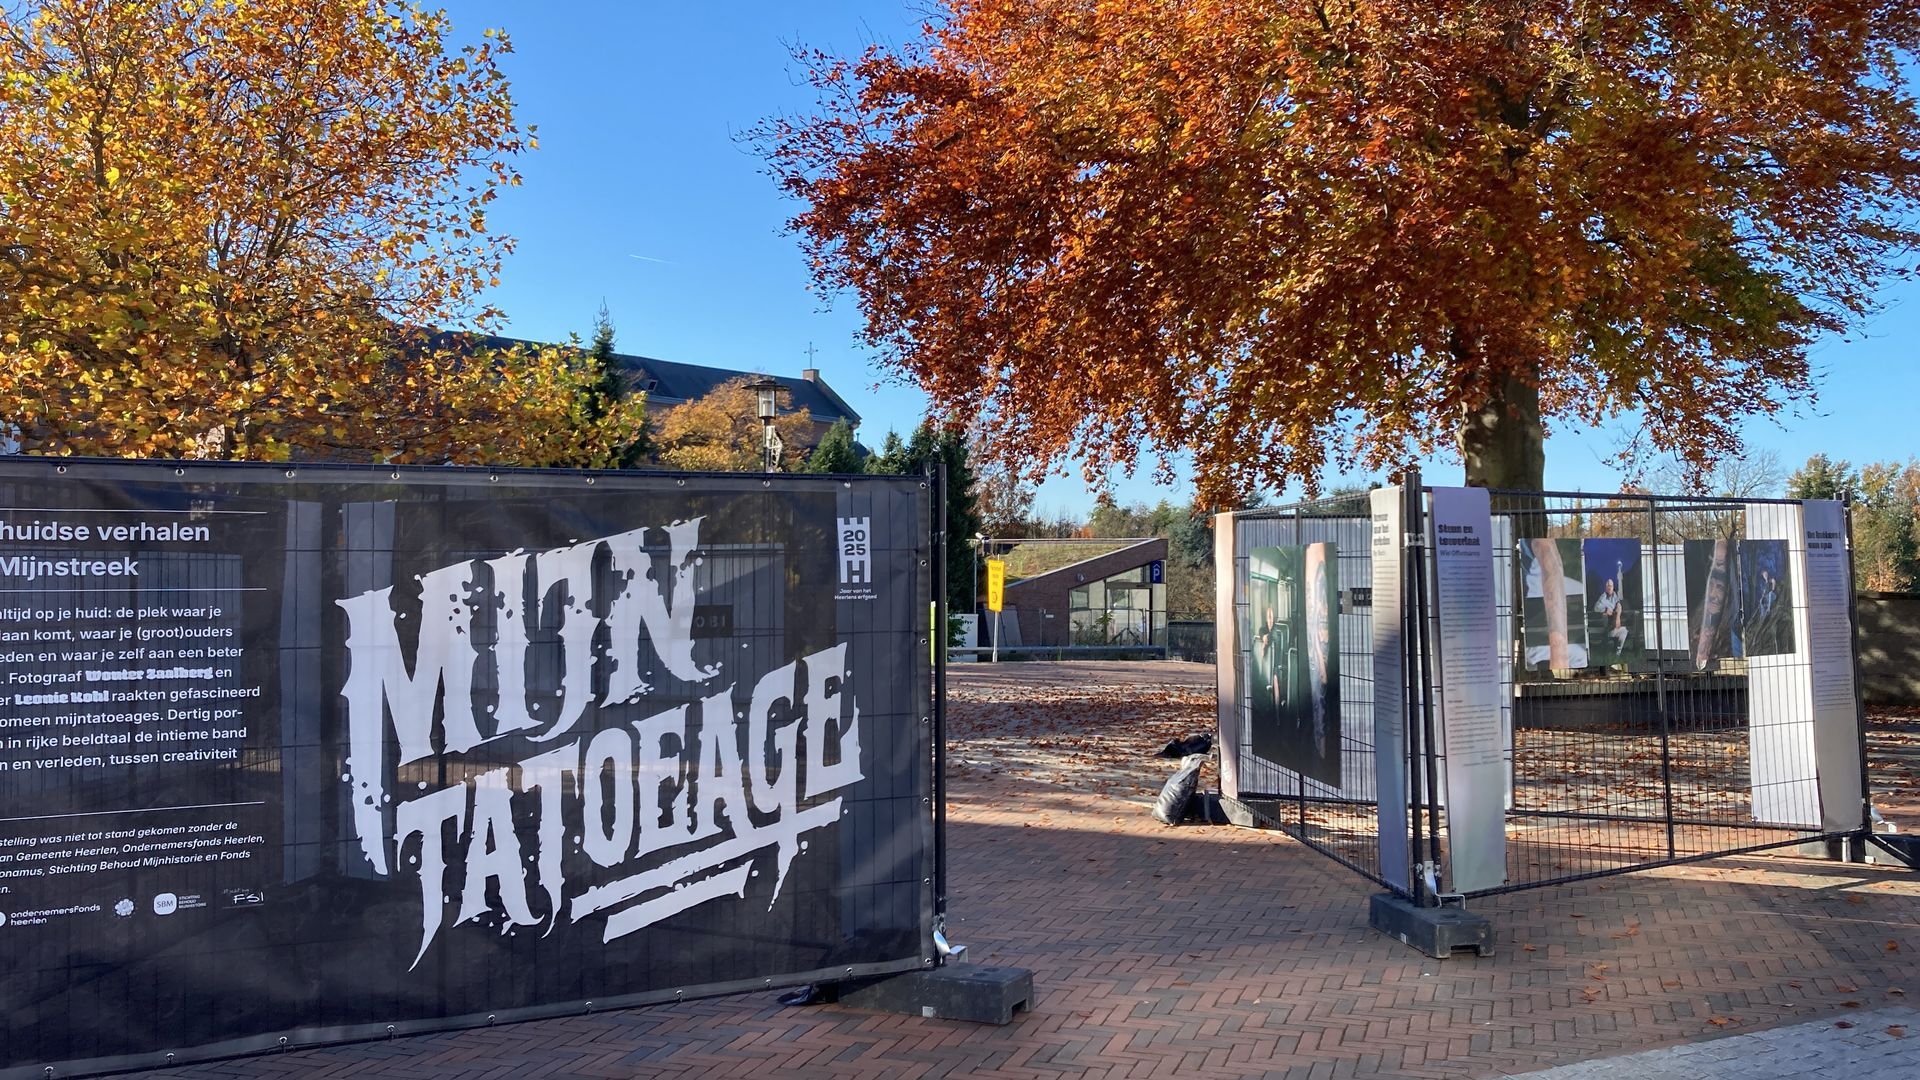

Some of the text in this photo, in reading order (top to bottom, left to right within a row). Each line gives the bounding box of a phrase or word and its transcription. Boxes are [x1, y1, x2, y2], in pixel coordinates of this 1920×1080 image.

[0, 520, 210, 541] huidse verhalen
[843, 529, 866, 542] 20
[844, 543, 866, 556] 25
[0, 556, 139, 581] Mijnstreek
[1153, 568, 1160, 581] P
[35, 609, 54, 622] op
[58, 607, 71, 621] je
[75, 607, 112, 618] huid:
[116, 607, 134, 618] de
[138, 606, 168, 620] plek
[171, 608, 206, 617] waar
[208, 605, 222, 619] je
[0, 626, 233, 642] aan komt, waar je (groot)ouders
[38, 652, 57, 662] en
[61, 651, 98, 661] waar
[100, 649, 114, 663] je
[118, 647, 145, 660] zelf
[148, 650, 174, 659] aan
[178, 649, 204, 658] een
[207, 646, 244, 658] beter
[9, 670, 82, 686] Fotograaf
[215, 669, 232, 678] en
[112, 689, 166, 702] raakten
[169, 686, 261, 702] gefascineerd
[335, 515, 722, 875] MIJN
[0, 708, 243, 728] omeen mijntatoeages. Dertig por-
[8, 737, 21, 749] in
[26, 736, 58, 750] rijke
[62, 732, 131, 746] beeldtaal
[134, 731, 153, 743] de
[156, 729, 209, 742] intieme
[212, 727, 247, 739] band
[12, 760, 31, 770] en
[35, 755, 106, 769] verleden,
[109, 754, 159, 765] tussen
[162, 747, 238, 762] creativiteit
[395, 642, 866, 973] TATOEAGE
[39, 835, 62, 845] was
[64, 832, 86, 842] niet
[87, 831, 103, 840] tot
[104, 828, 136, 839] stand
[137, 826, 185, 839] gekomen
[187, 822, 224, 833] zonder
[224, 821, 238, 830] de
[16, 849, 72, 862] Gemeente
[74, 846, 119, 857] Heerlen,
[122, 837, 222, 853] Ondernemersfonds
[223, 834, 265, 846] Heerlen,
[48, 863, 98, 875] Stichting
[99, 858, 141, 871] Behoud
[142, 853, 203, 868] Mijnhistorie
[205, 853, 218, 862] en
[220, 850, 251, 861] Fonds
[0, 885, 11, 894] n.
[156, 900, 174, 908] SBM
[10, 917, 48, 926] heerlen
